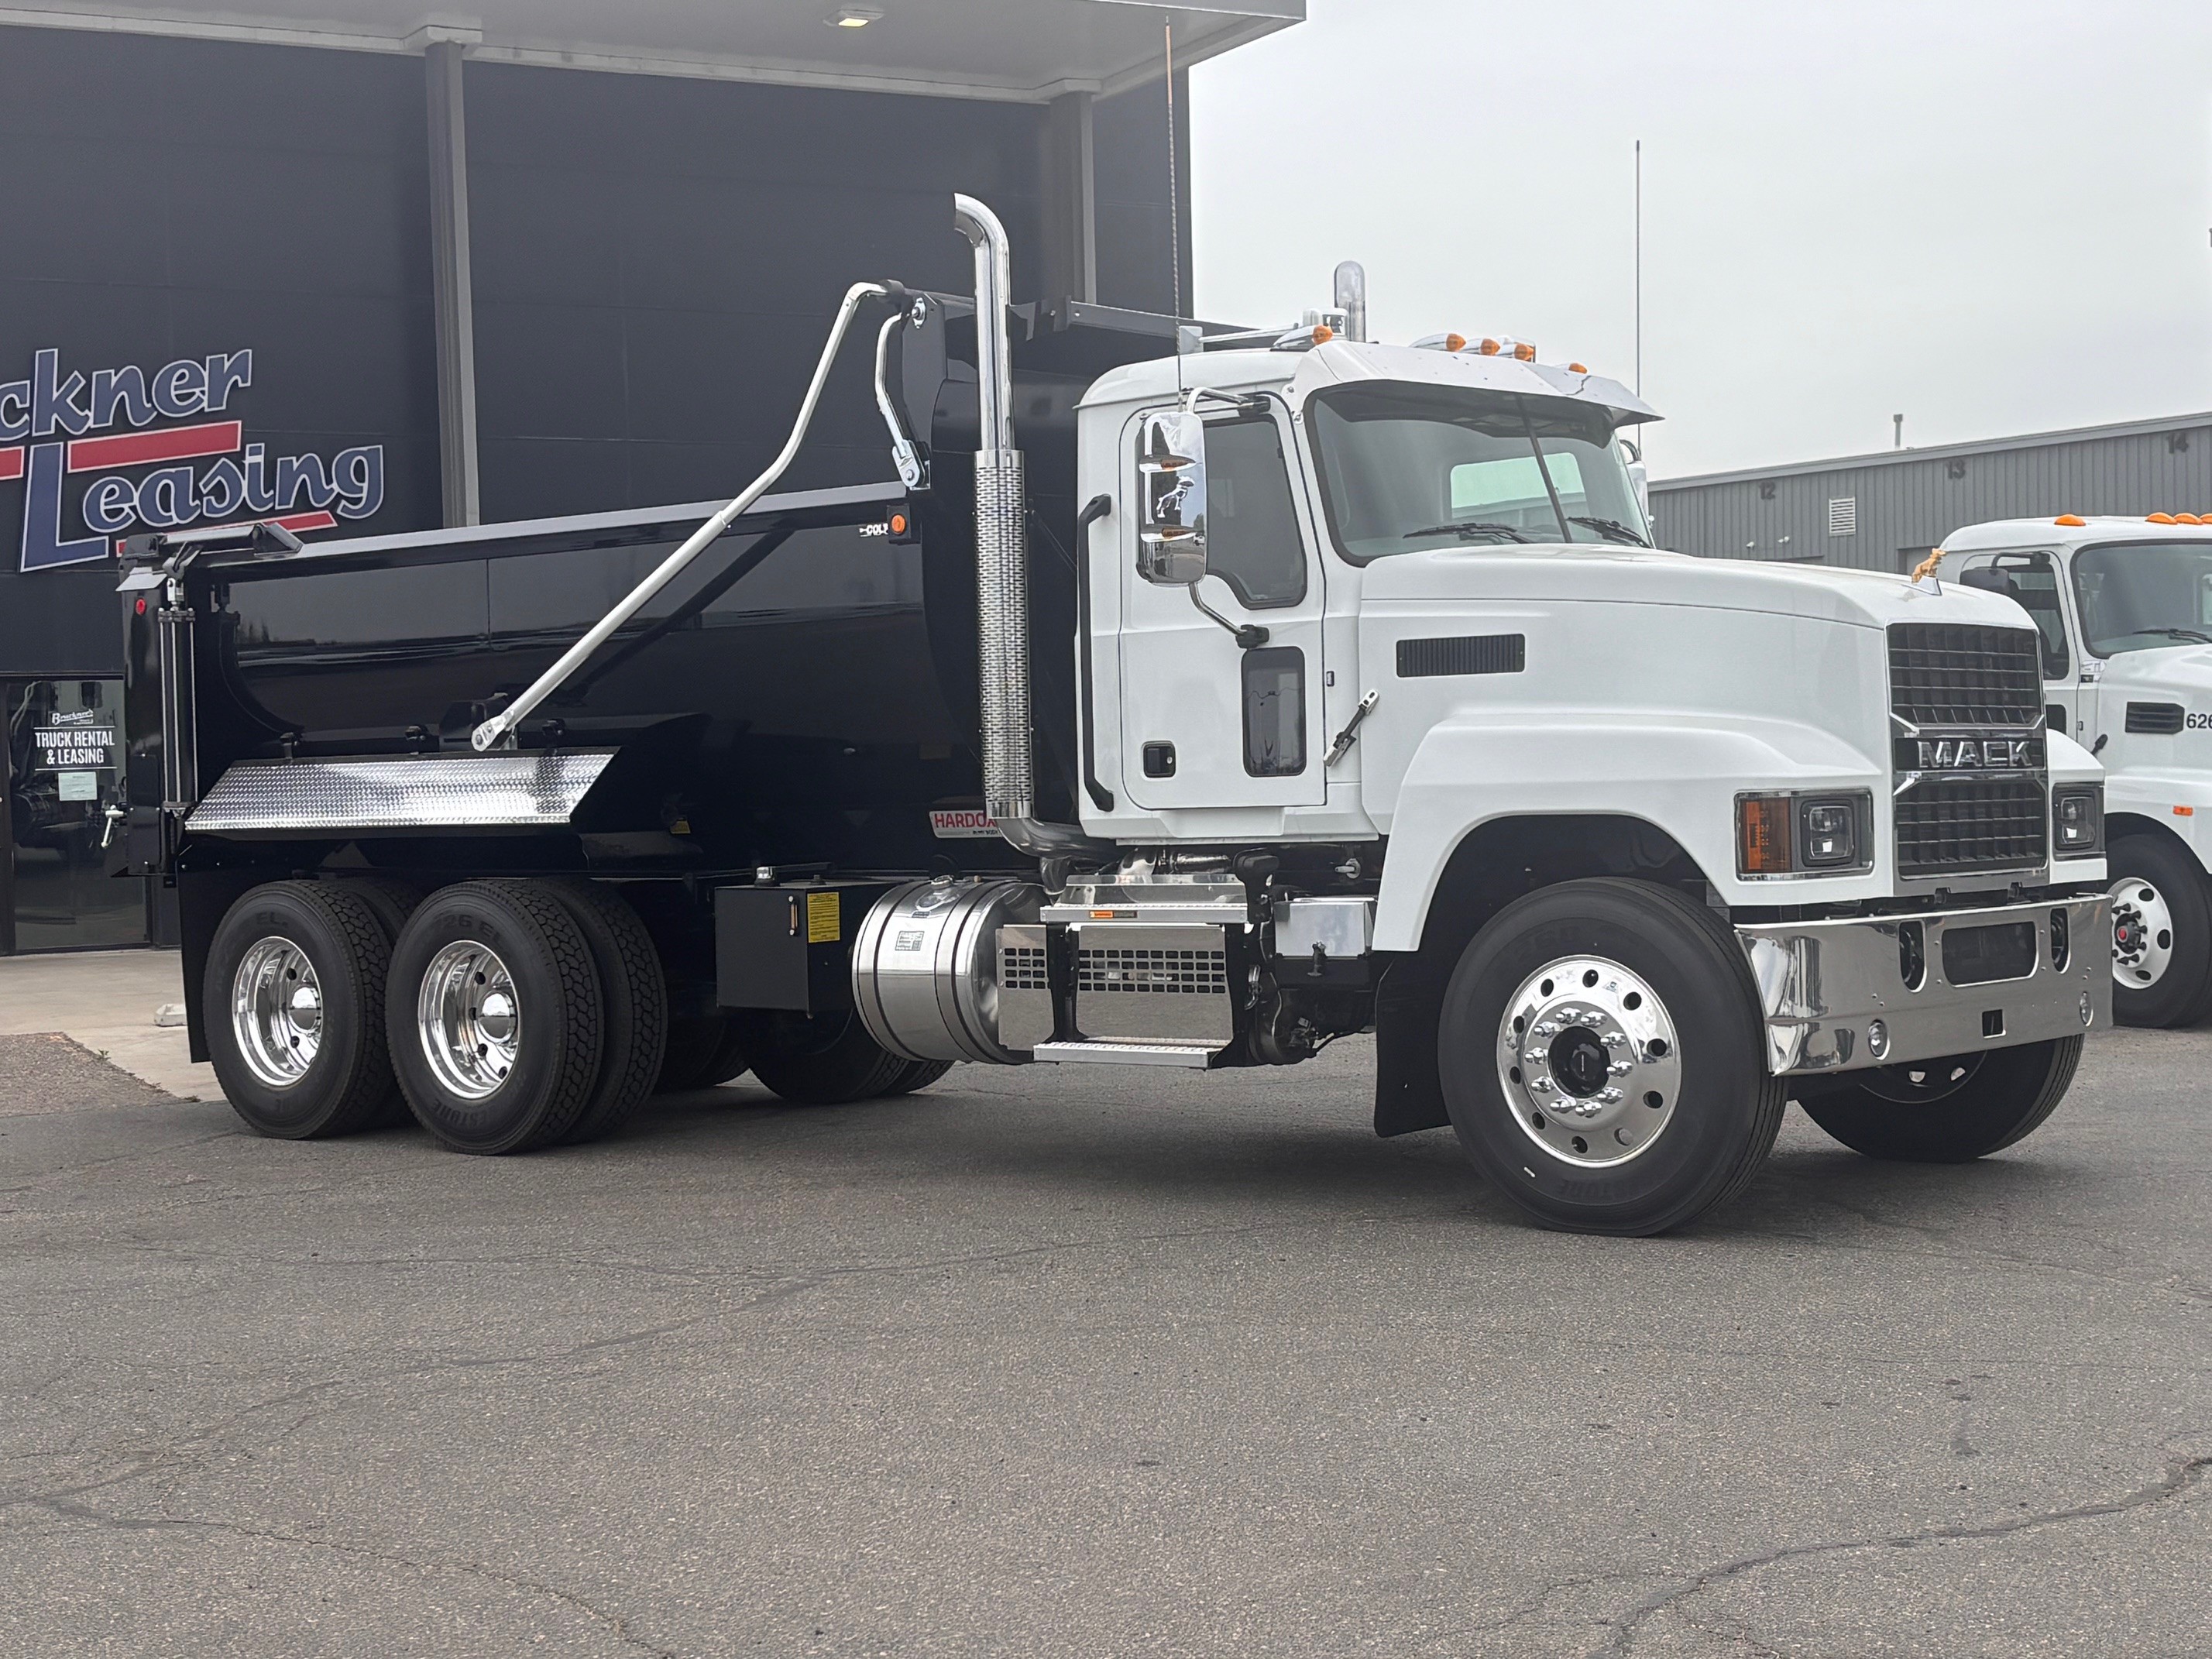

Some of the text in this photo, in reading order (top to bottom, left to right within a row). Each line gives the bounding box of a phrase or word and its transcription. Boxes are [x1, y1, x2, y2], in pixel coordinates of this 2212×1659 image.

[2166, 432, 2189, 454] 14
[1945, 459, 1966, 479] 13
[1759, 481, 1775, 500] 12
[20, 441, 384, 572] Leasing
[35, 731, 115, 747] TRUCK RENTAL
[46, 748, 104, 764] & LEASING
[1917, 740, 2032, 768] MACK
